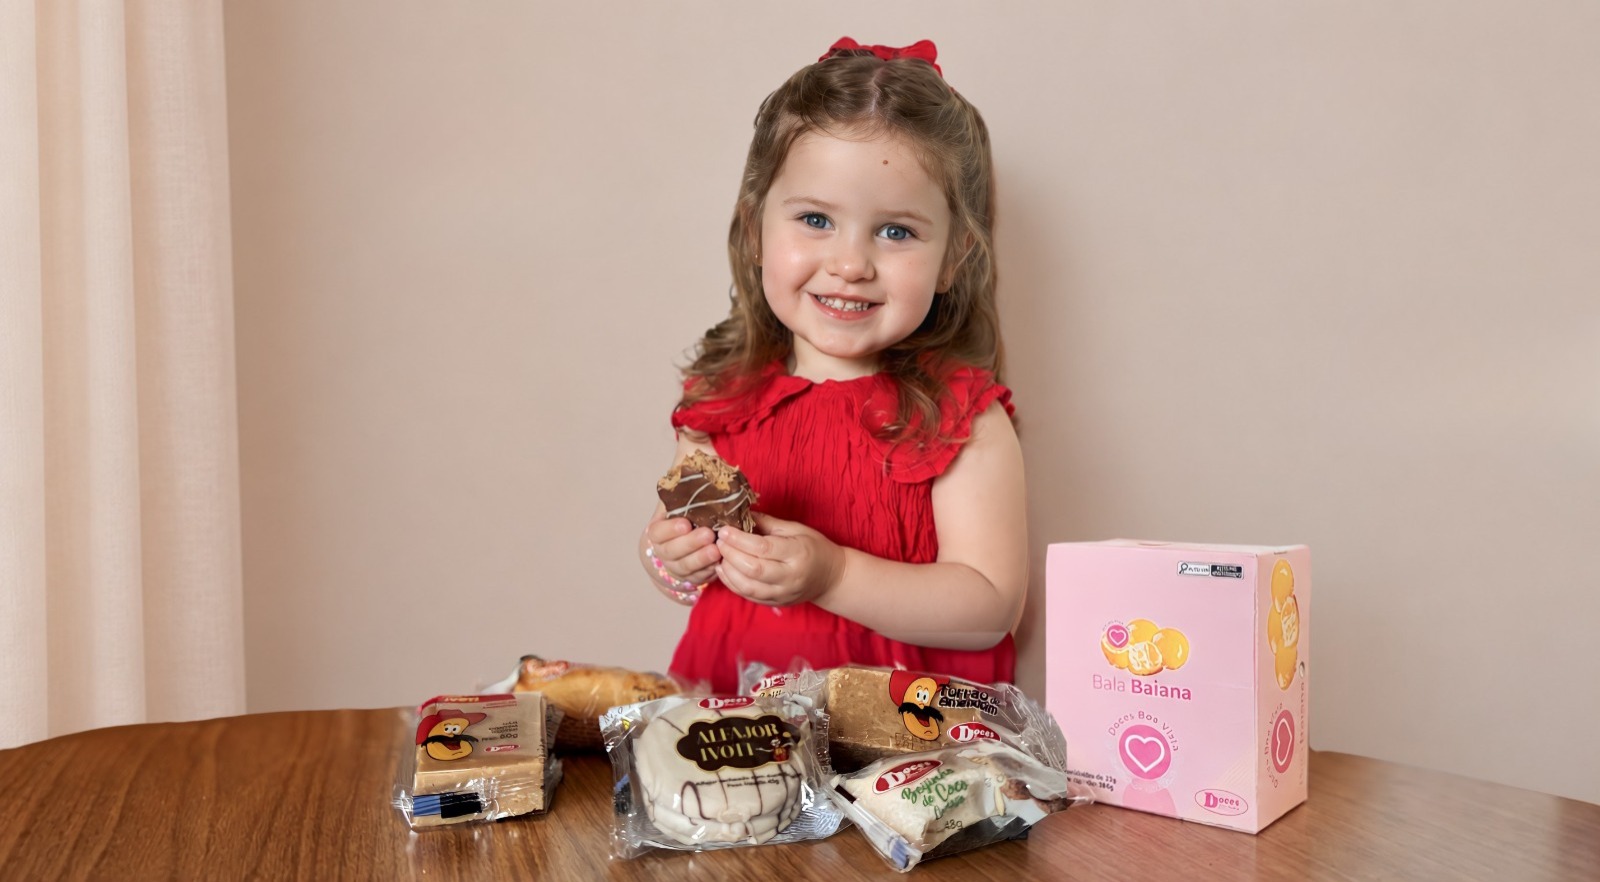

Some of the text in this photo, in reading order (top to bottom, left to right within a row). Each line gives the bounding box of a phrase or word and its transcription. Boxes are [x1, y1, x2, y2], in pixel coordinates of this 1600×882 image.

[1092, 674, 1192, 701] Bala Baiana
[958, 725, 995, 742] Doces
[1108, 713, 1135, 736] Doces
[1138, 711, 1159, 724] Boa
[699, 723, 780, 747] ALFAJOR
[700, 742, 755, 762] IVOTI
[884, 761, 931, 788] Doces
[922, 794, 934, 806] de
[1204, 792, 1240, 808] Doces
